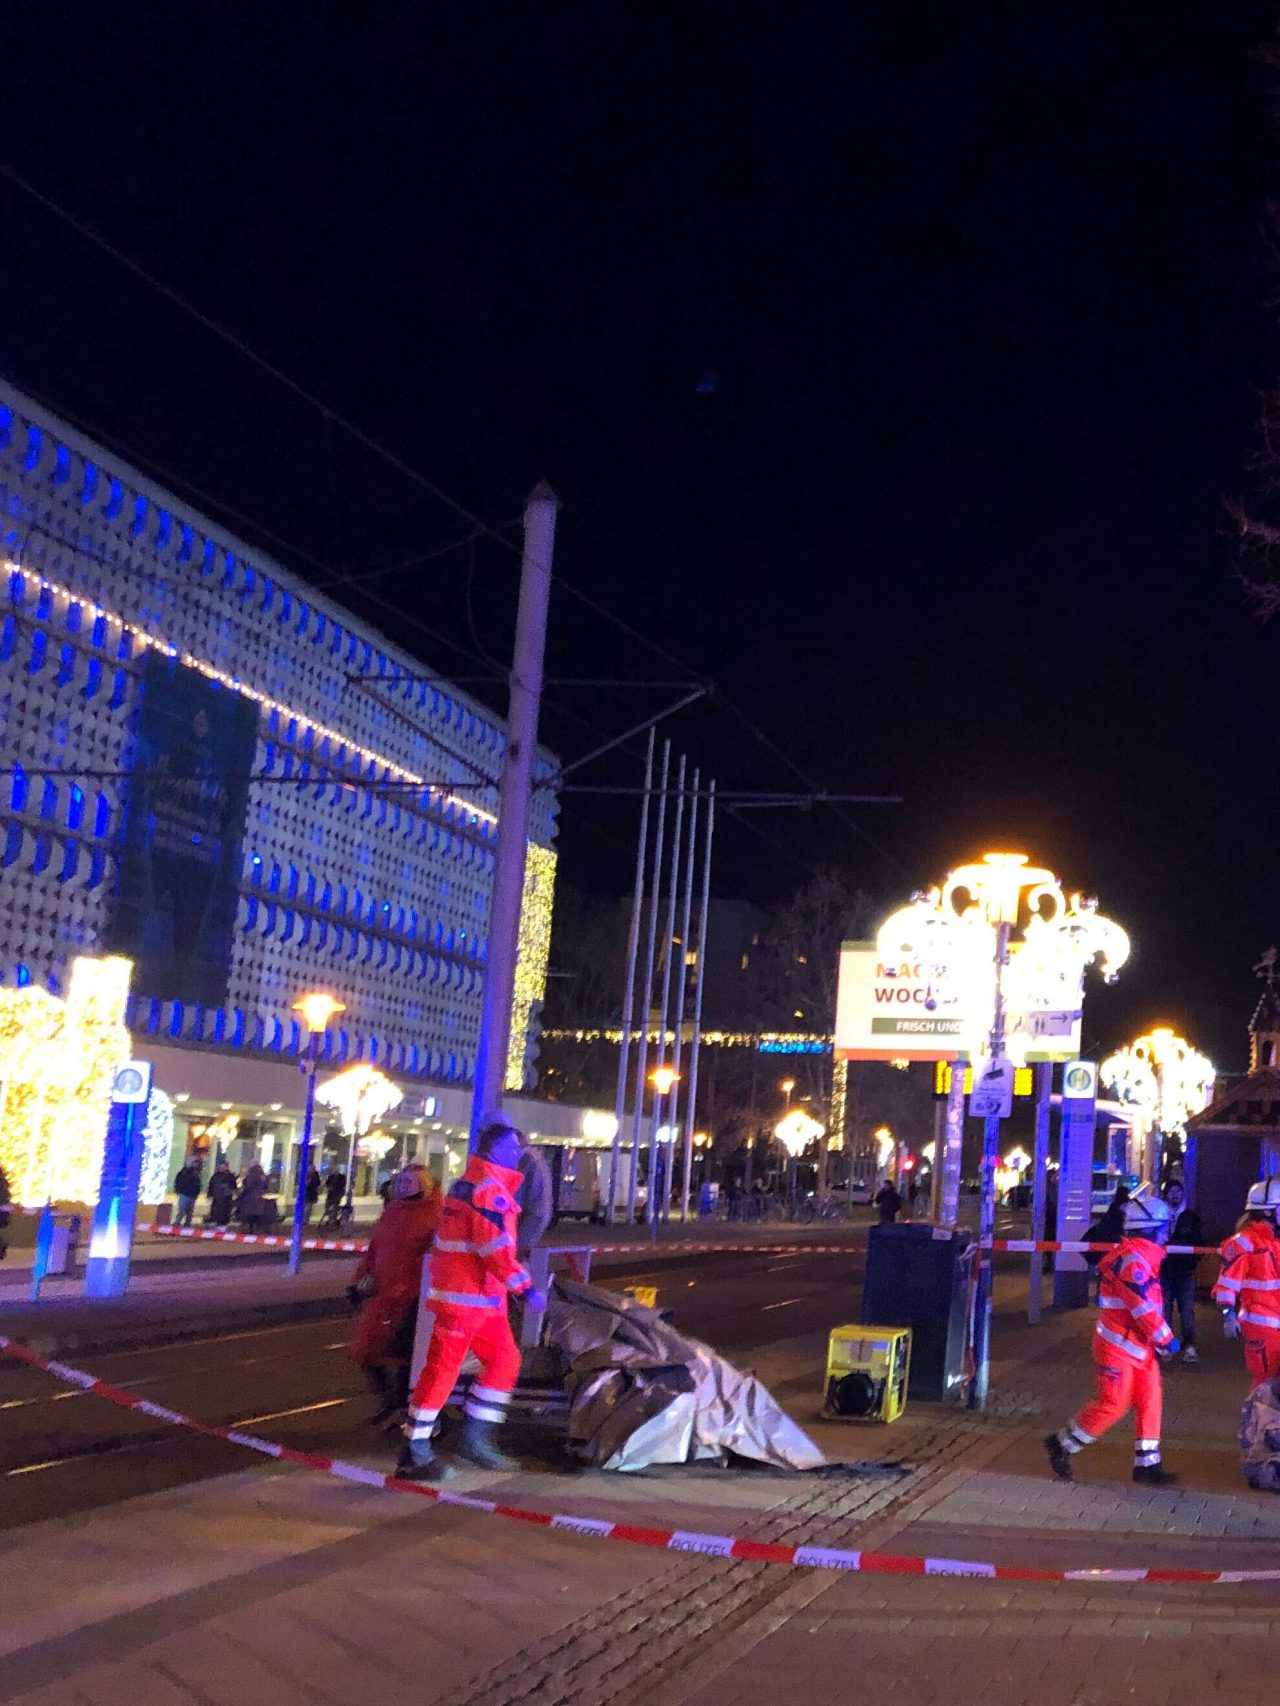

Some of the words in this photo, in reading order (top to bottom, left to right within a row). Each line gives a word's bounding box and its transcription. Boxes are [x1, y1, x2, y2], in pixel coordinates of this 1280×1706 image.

[874, 987, 926, 1004] WOC
[896, 1021, 935, 1032] FRISCH
[671, 1539, 727, 1557] POLIZEI
